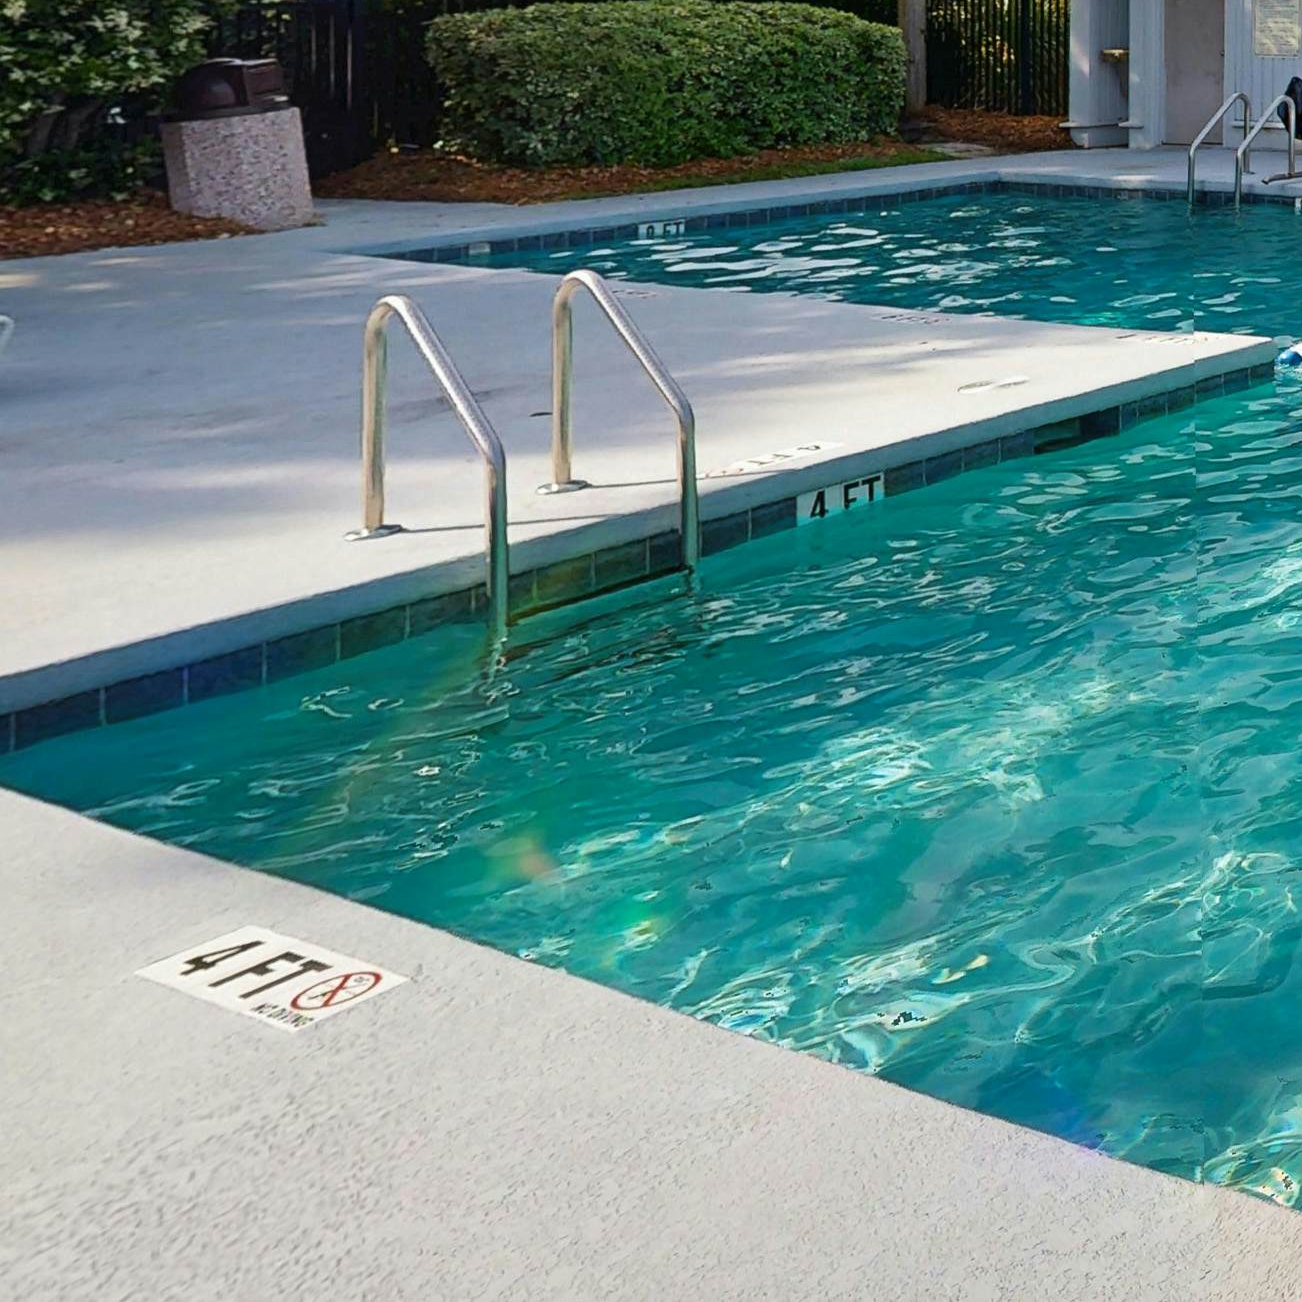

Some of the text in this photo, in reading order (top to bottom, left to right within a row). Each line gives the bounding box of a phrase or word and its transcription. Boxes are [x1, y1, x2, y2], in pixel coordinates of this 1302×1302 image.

[809, 474, 883, 519] 4 FT
[179, 940, 334, 999] 4 FT
